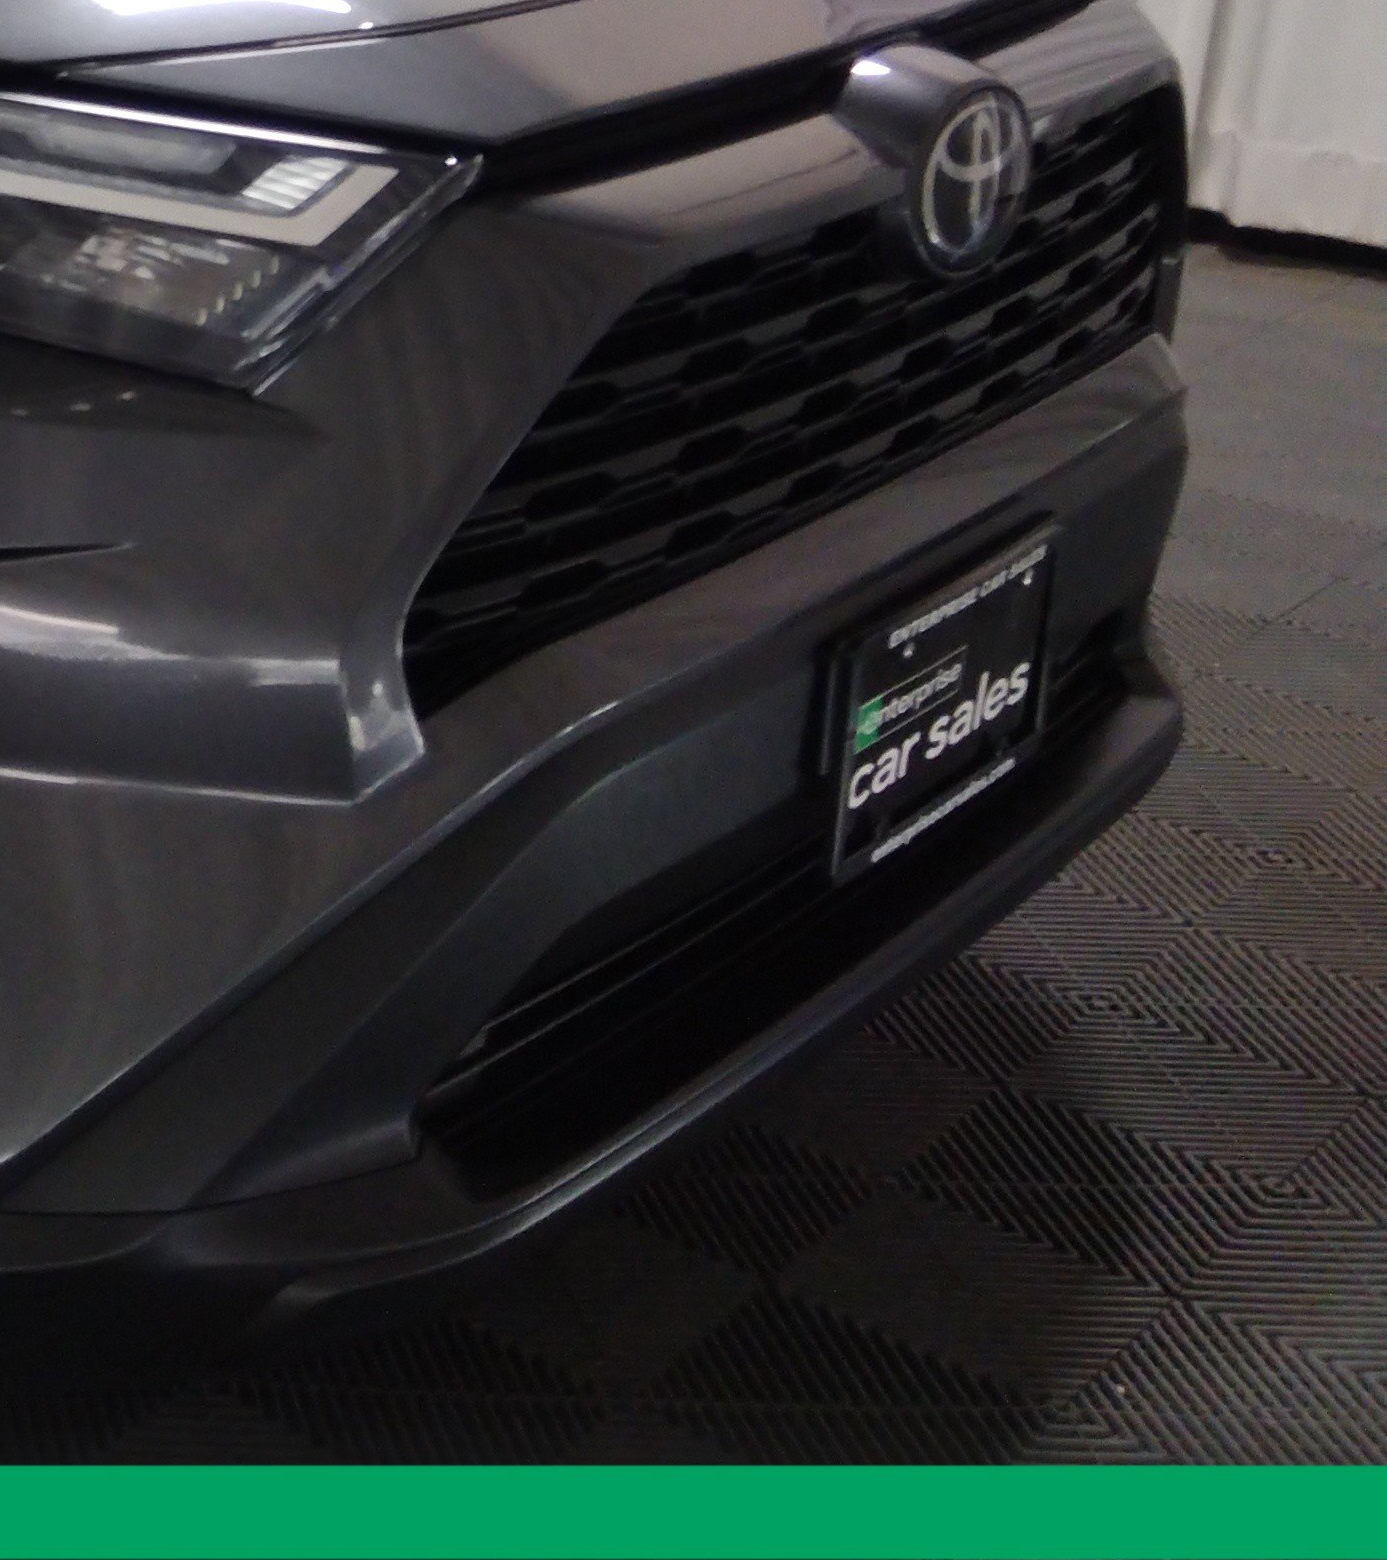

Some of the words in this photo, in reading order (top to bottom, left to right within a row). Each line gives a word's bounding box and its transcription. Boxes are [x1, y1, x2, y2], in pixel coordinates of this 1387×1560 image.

[847, 731, 922, 810] car
[925, 662, 1032, 760] sales
[856, 663, 963, 735] enterprise
